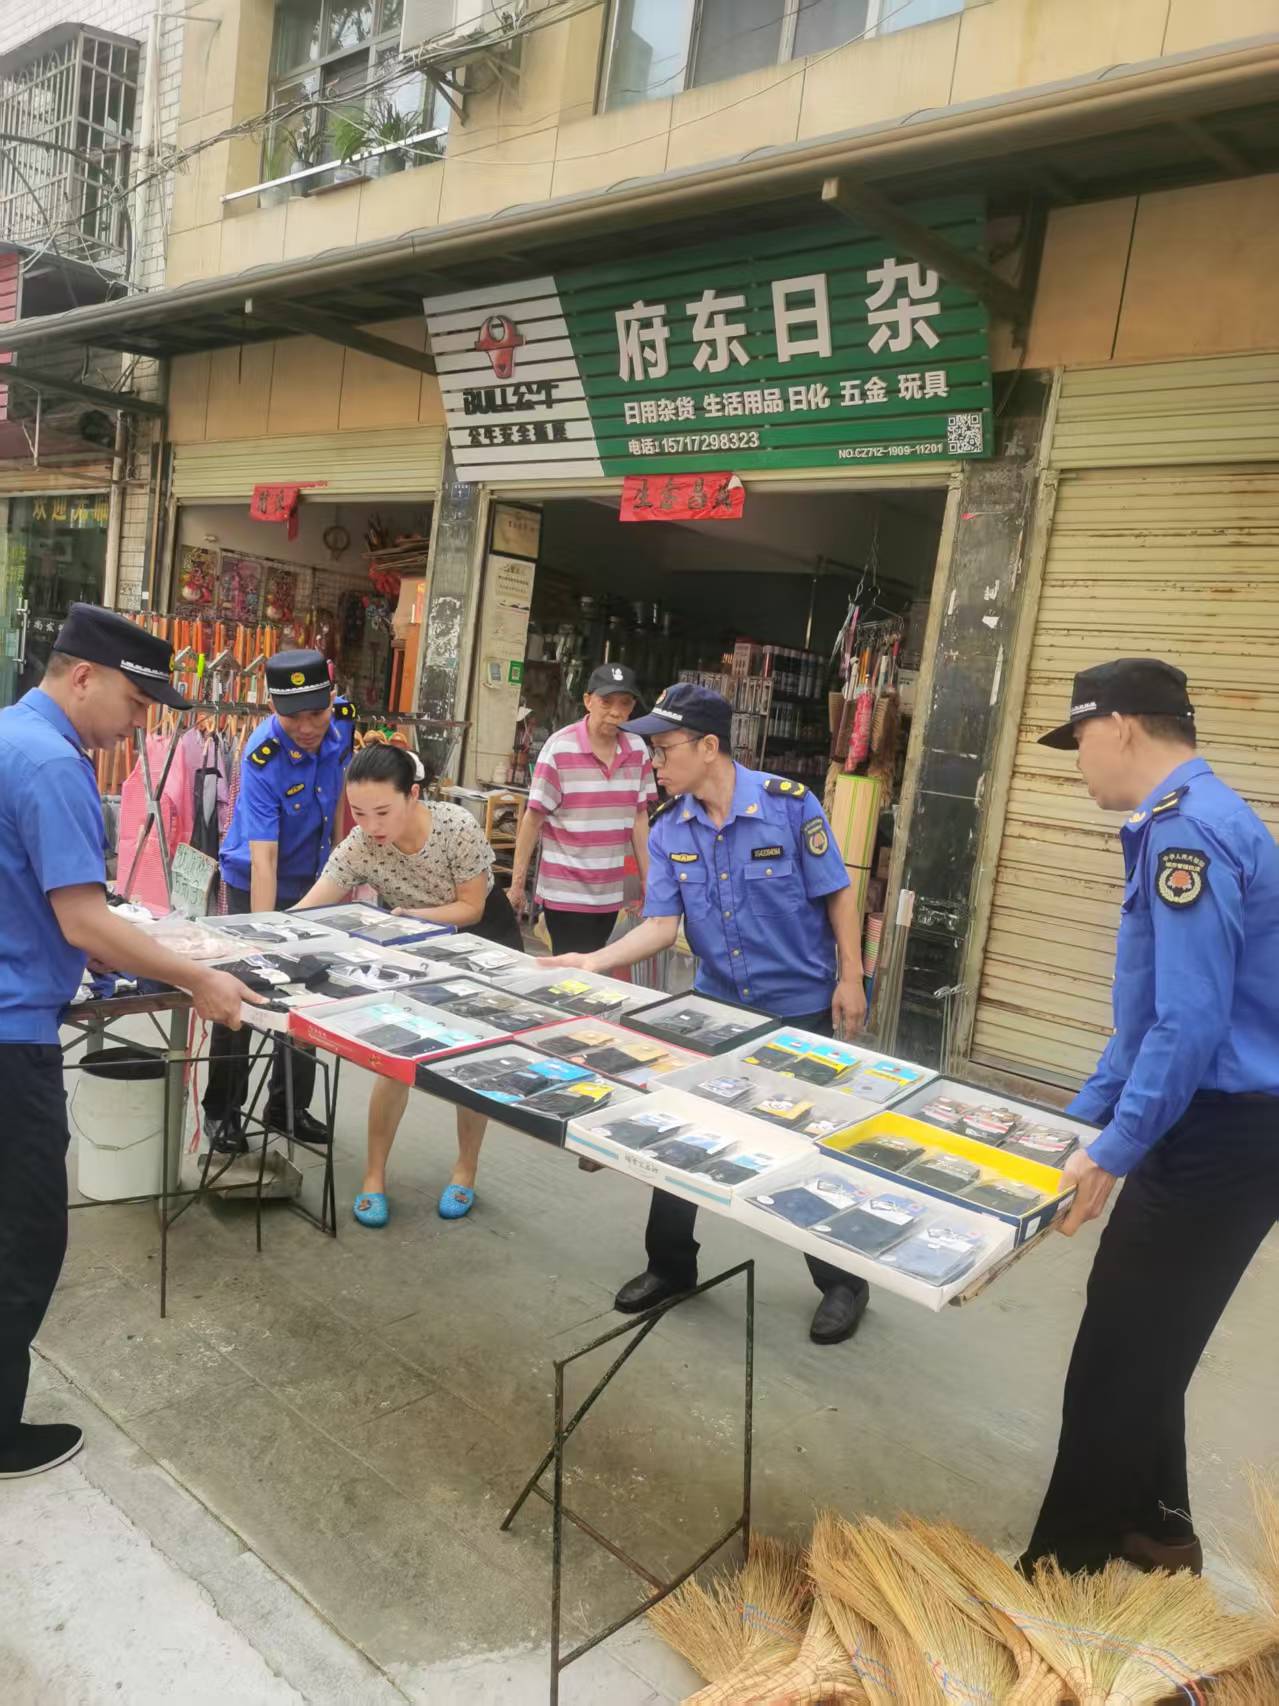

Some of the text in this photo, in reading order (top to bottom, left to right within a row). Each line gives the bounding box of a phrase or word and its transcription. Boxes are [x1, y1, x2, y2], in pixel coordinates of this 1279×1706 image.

[614, 257, 942, 382] 府东日杂
[623, 371, 949, 425] 日用杂货 生活用品 日化 五金 玩具
